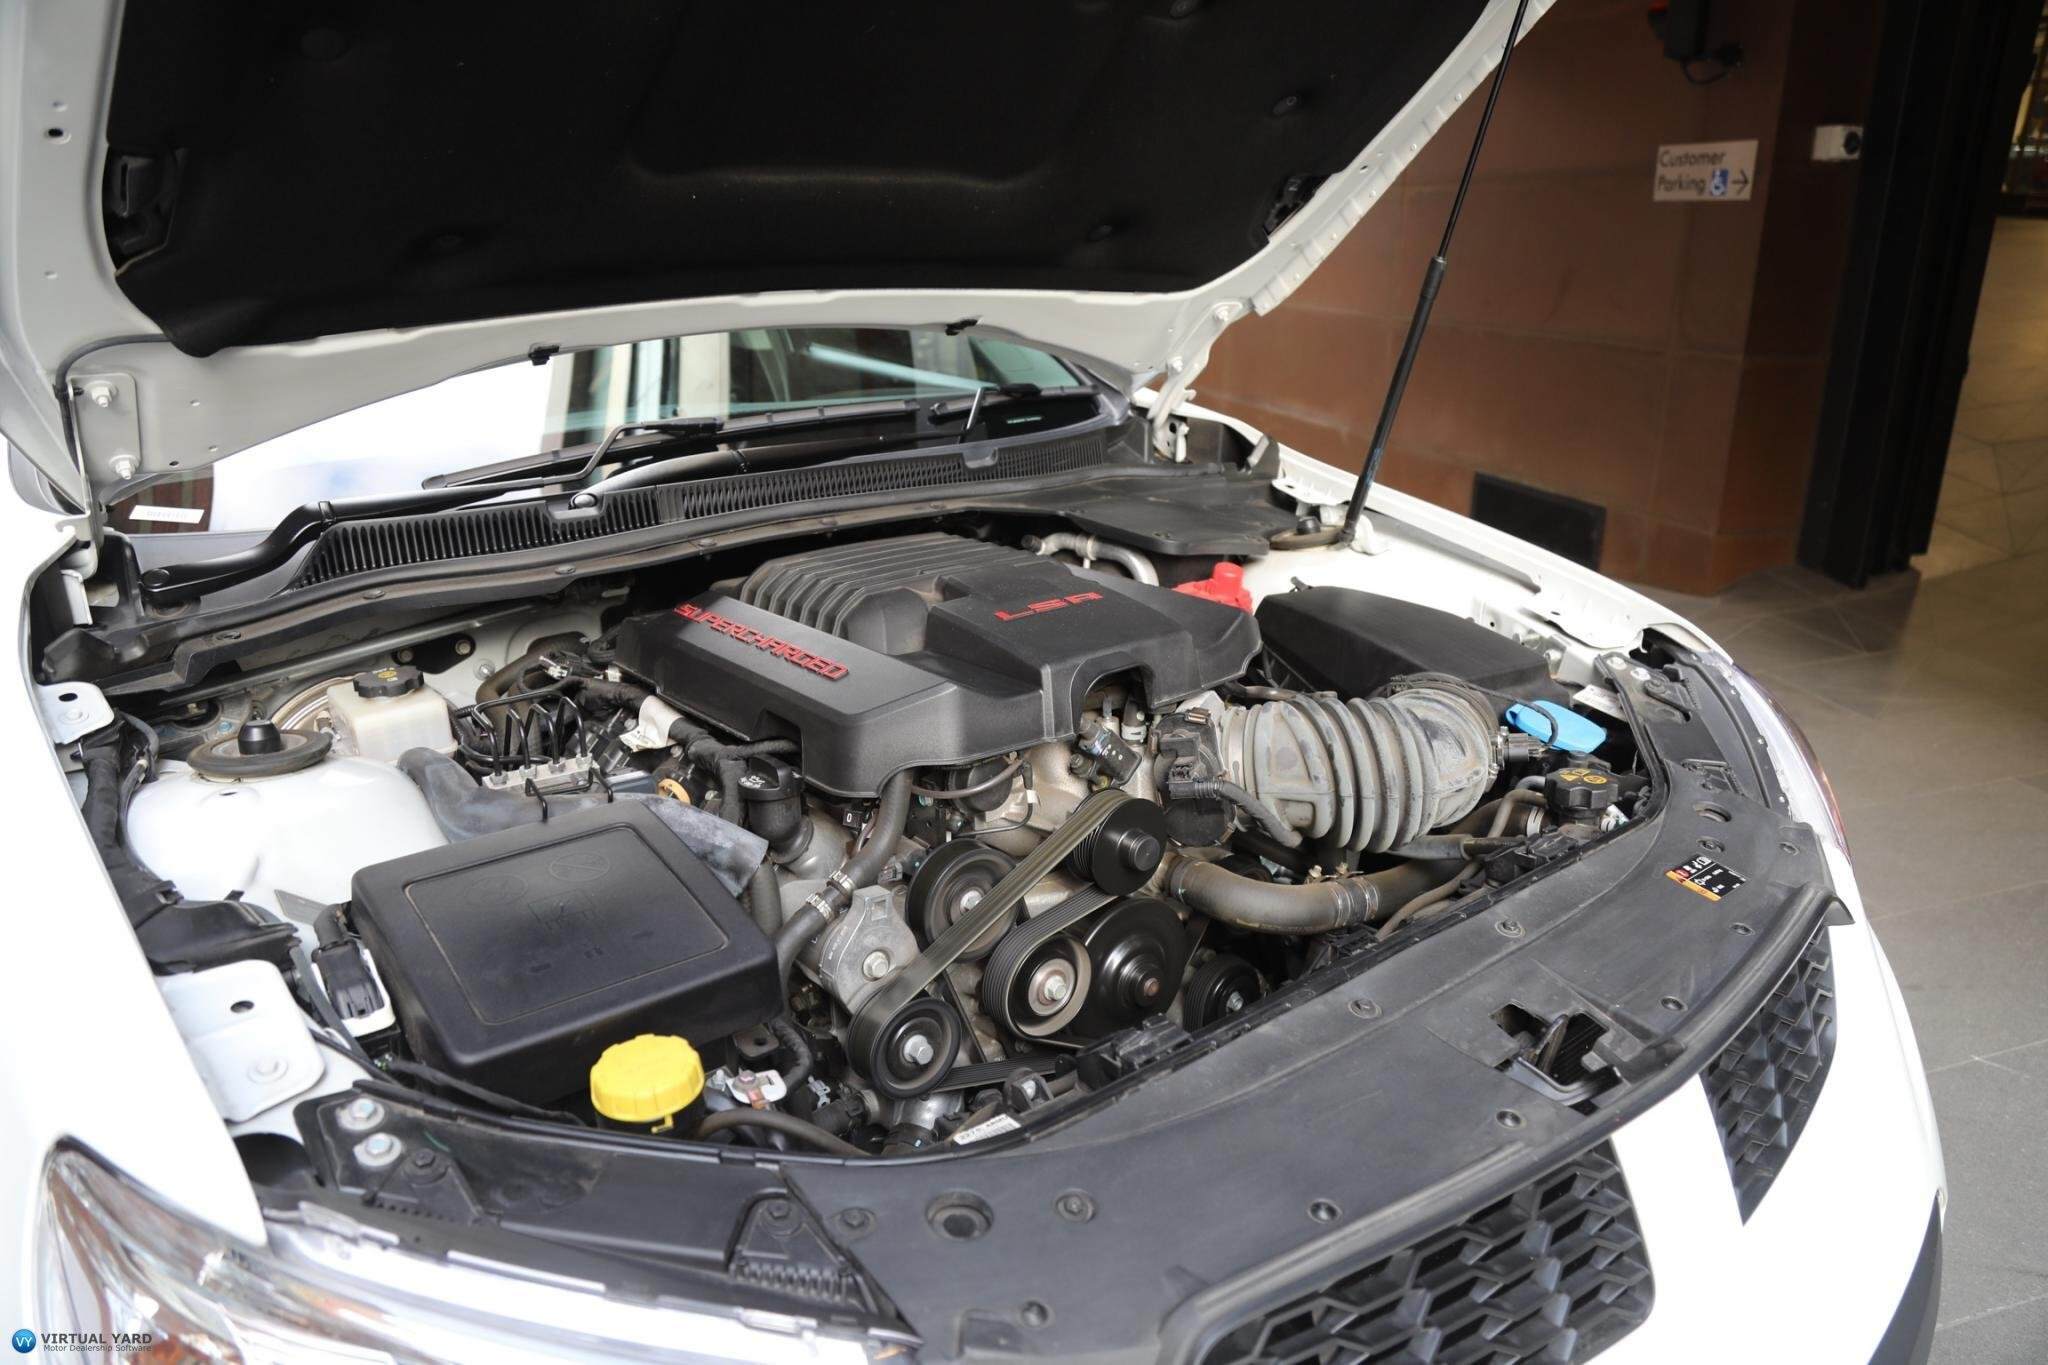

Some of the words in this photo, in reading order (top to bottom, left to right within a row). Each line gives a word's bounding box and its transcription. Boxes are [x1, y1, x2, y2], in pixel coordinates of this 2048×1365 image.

[1660, 150, 1727, 168] Customer
[1658, 174, 1706, 197] Parking
[673, 603, 849, 681] SUPERCHARGED
